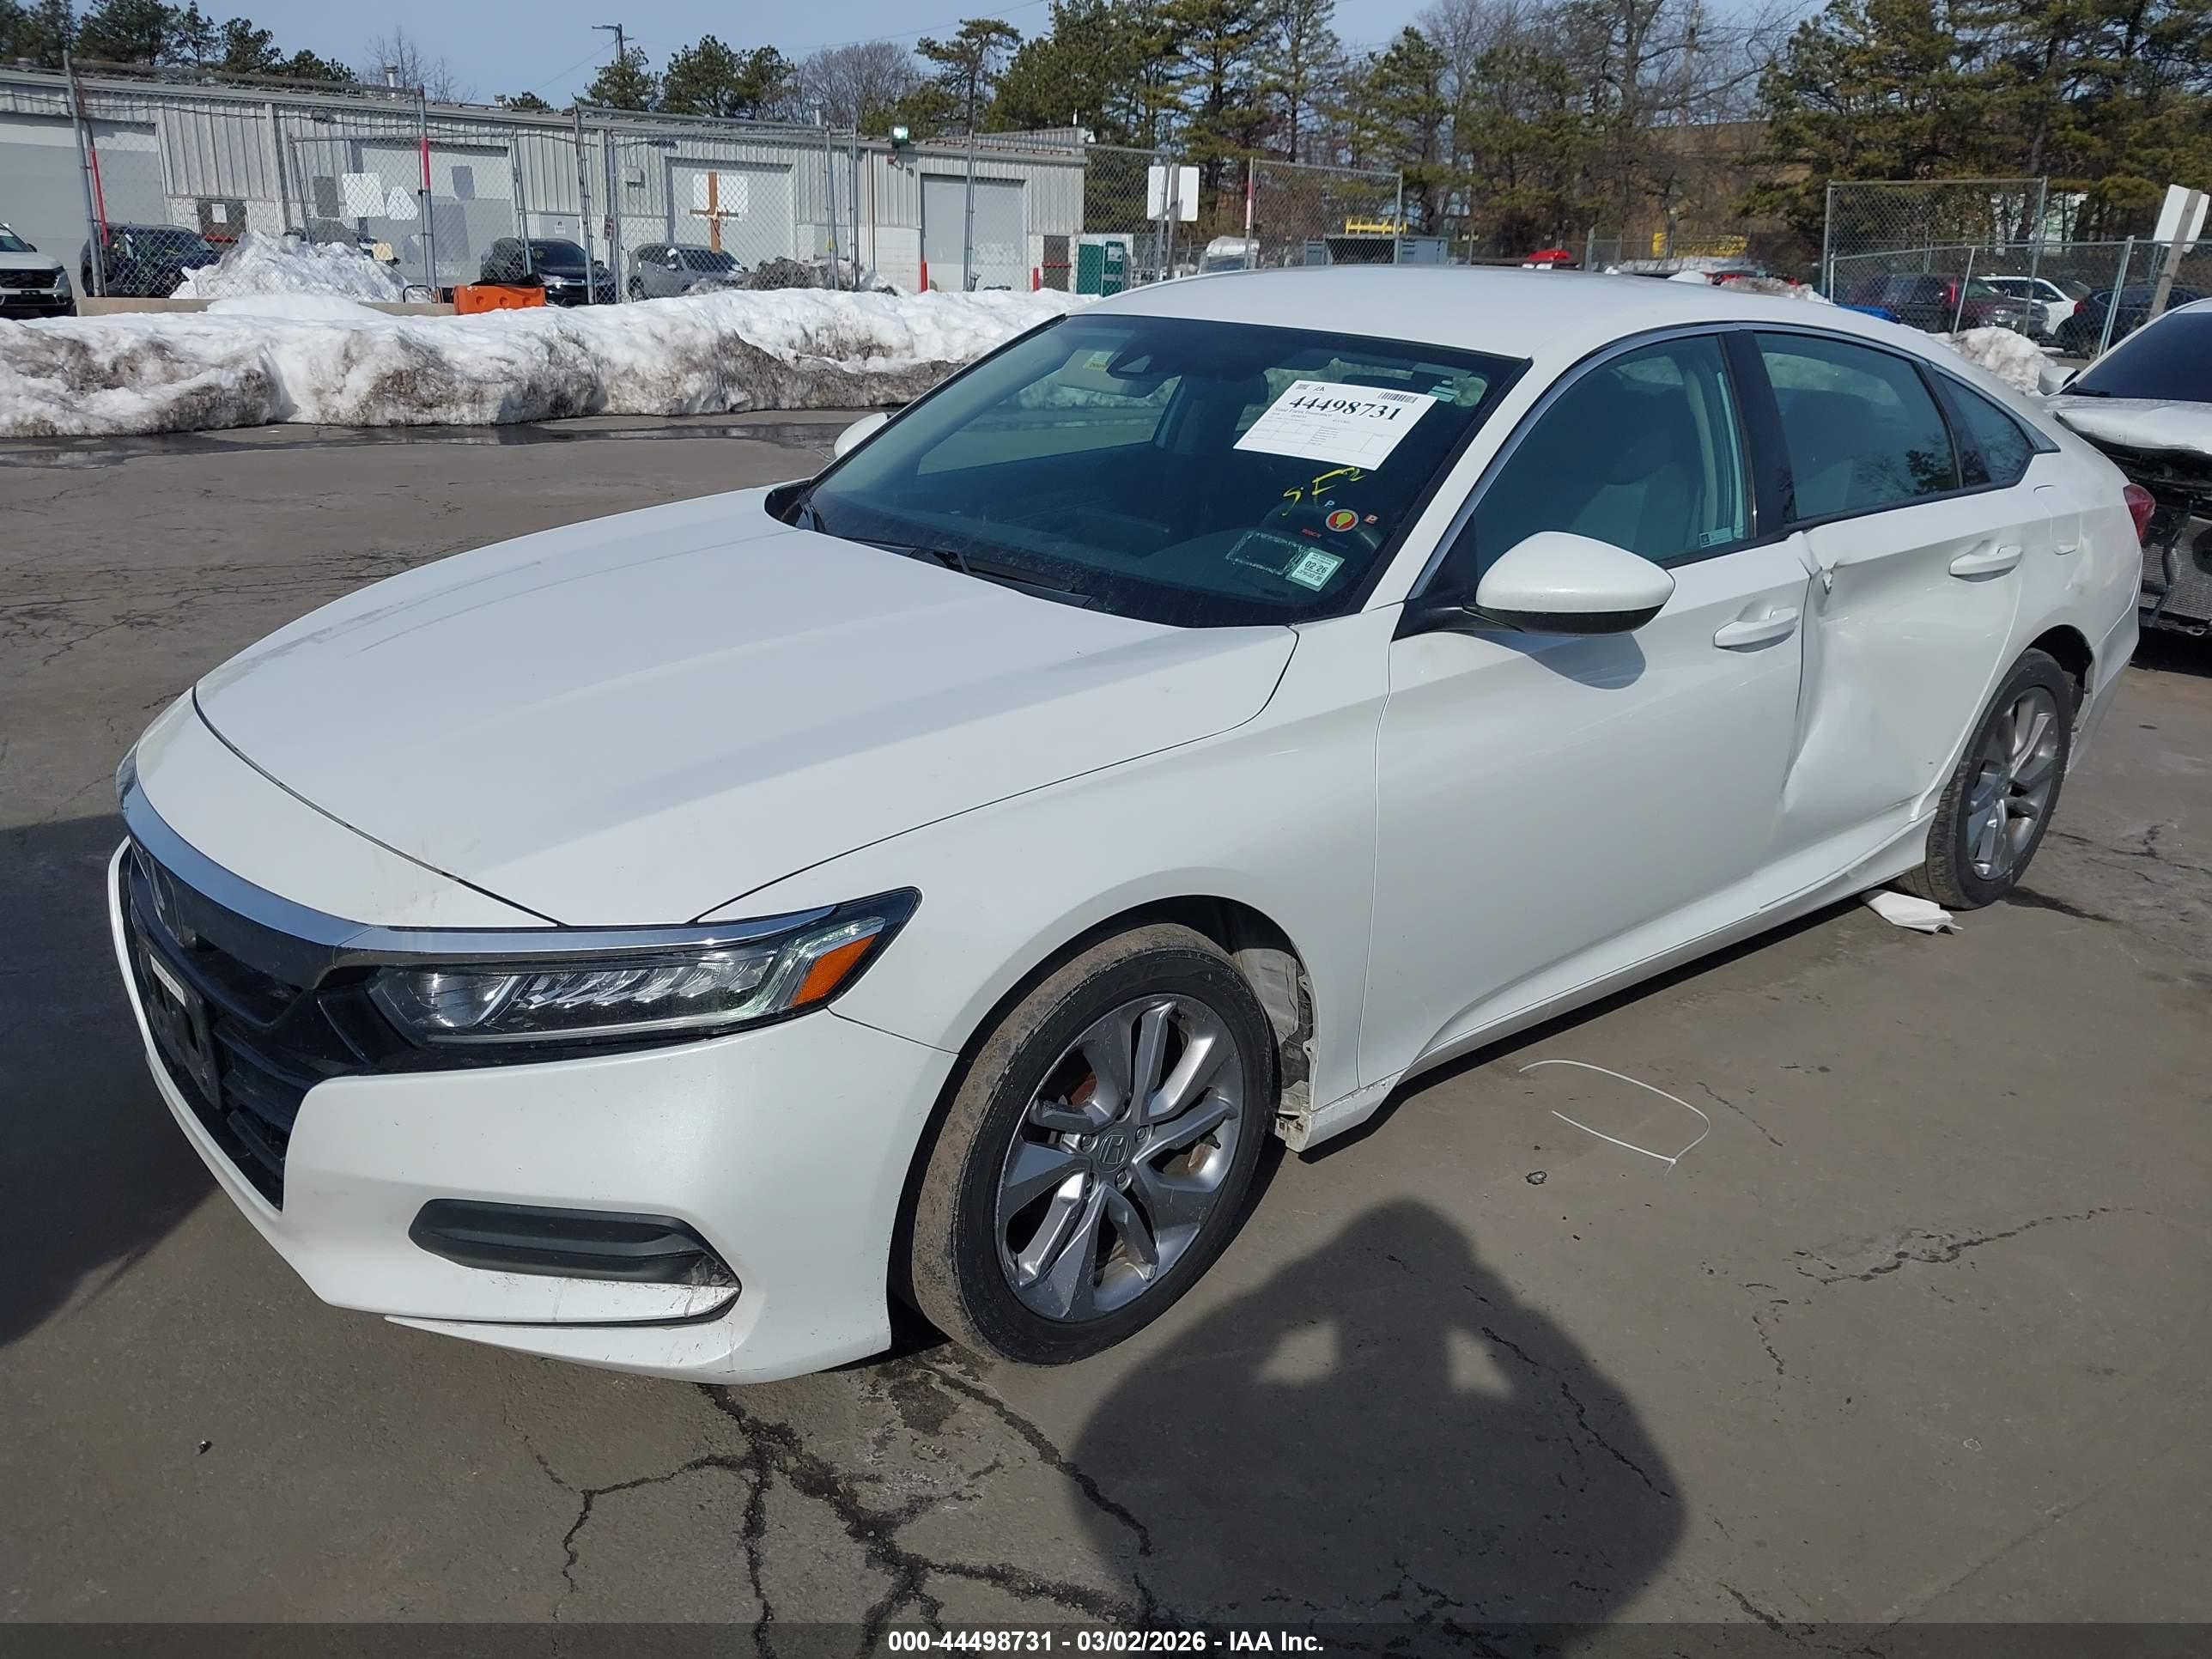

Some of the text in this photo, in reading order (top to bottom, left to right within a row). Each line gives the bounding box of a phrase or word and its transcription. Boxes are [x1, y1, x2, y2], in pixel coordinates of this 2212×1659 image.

[1288, 395, 1402, 421] 44498731
[1304, 560, 1316, 570] 02
[1316, 564, 1328, 574] 26
